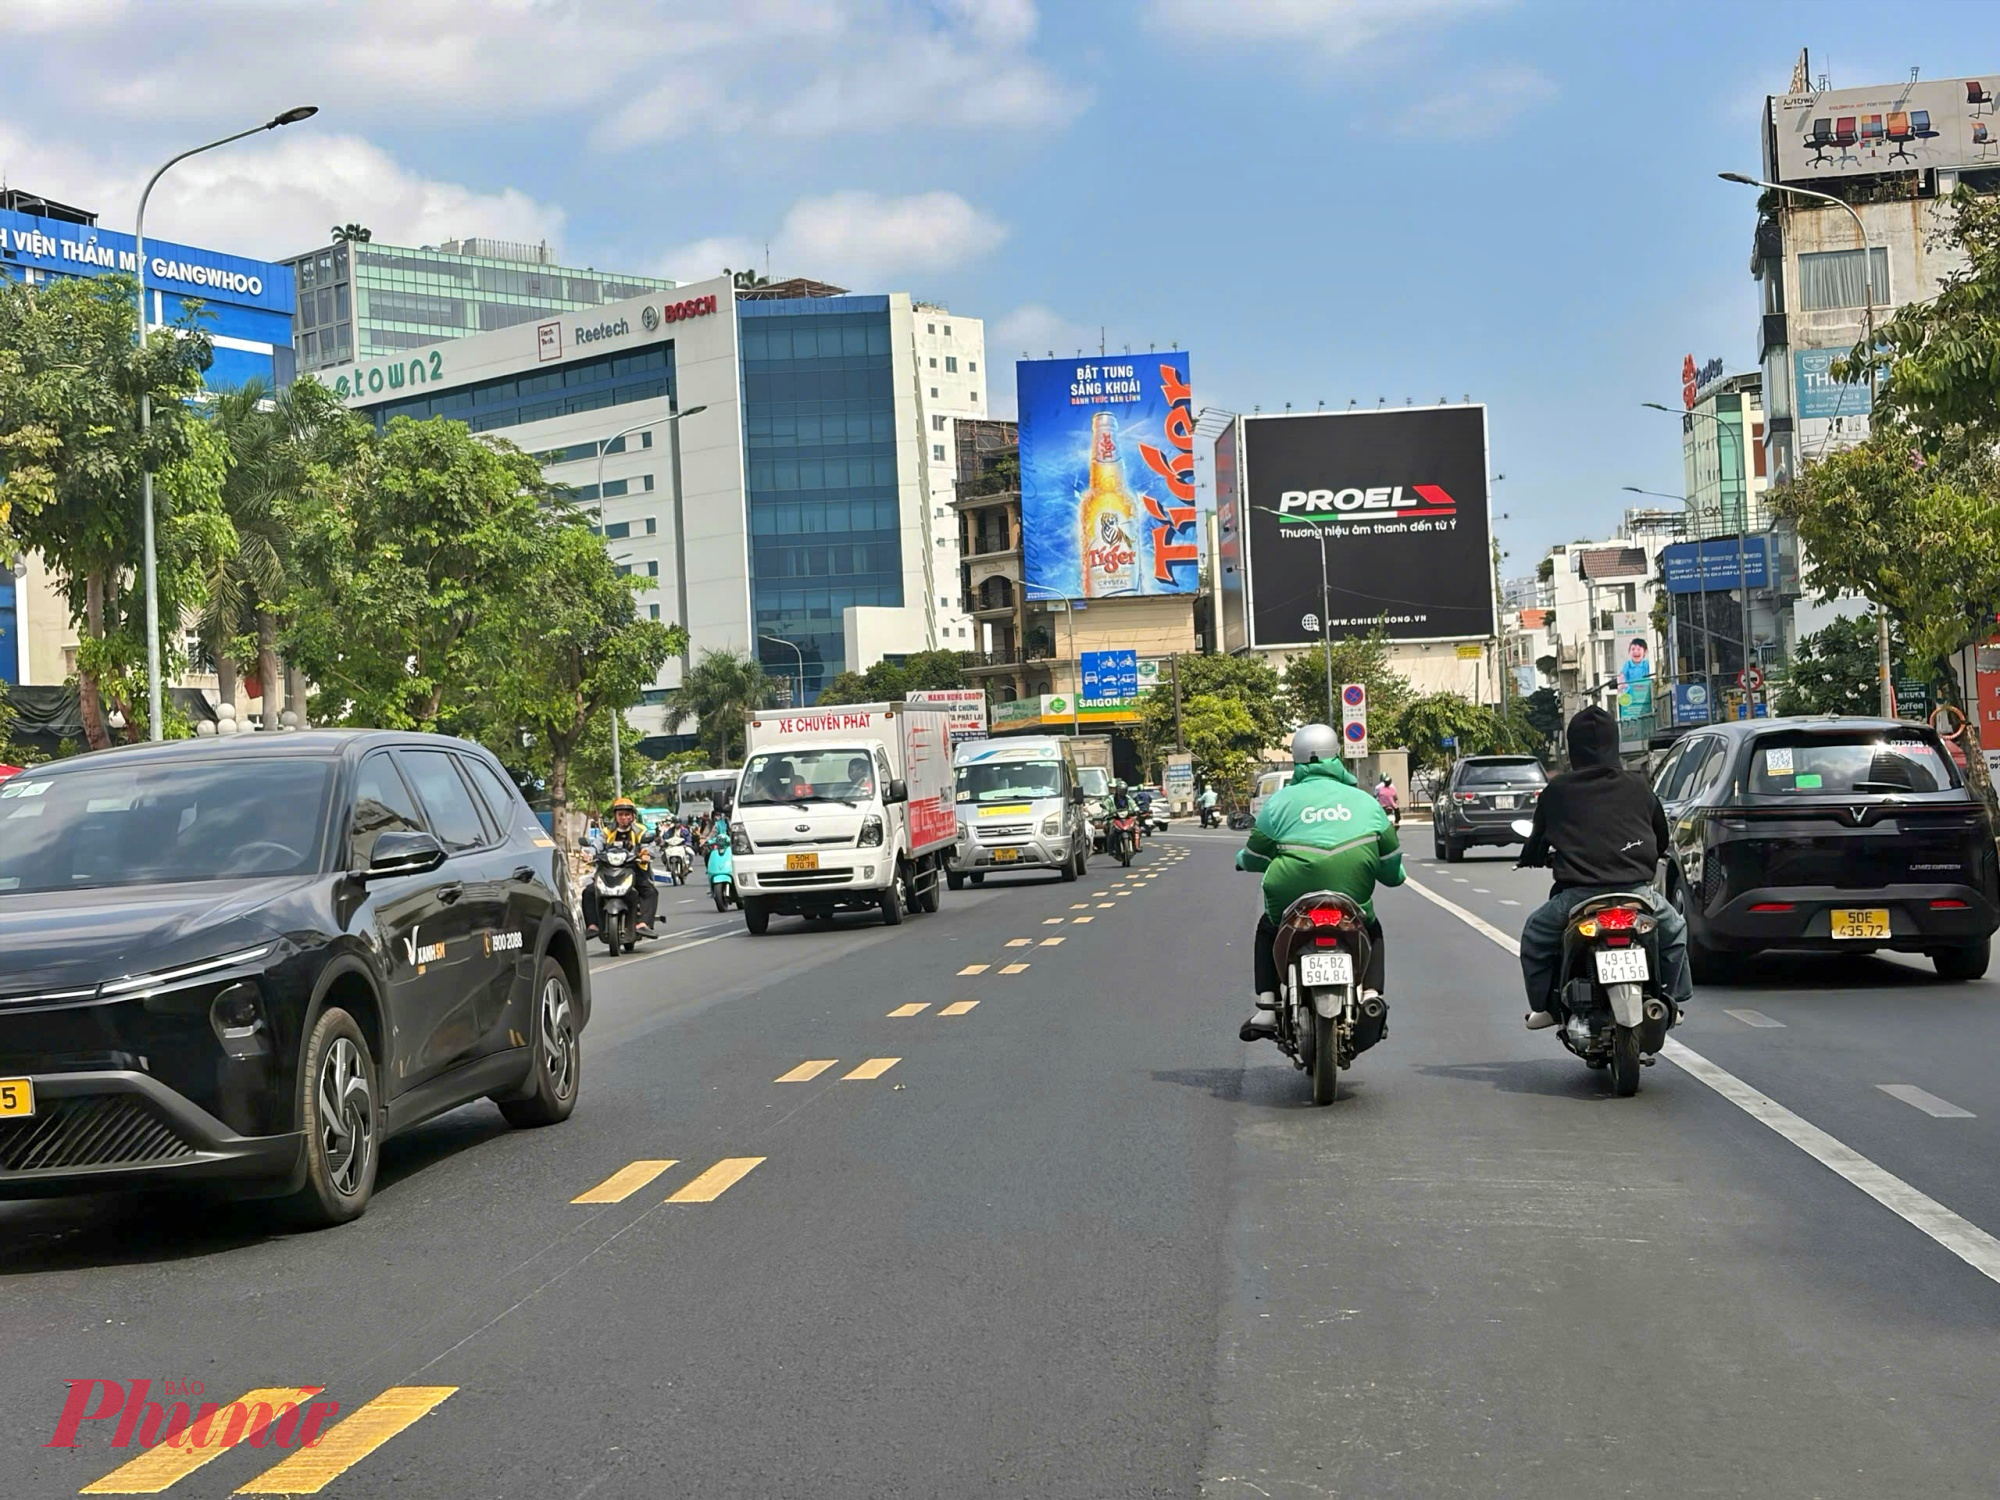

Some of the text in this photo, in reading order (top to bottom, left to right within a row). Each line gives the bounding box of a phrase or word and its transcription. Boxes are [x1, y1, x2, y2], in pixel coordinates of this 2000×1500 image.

[12, 229, 56, 259] VIỆN
[61, 236, 114, 269] THẨM
[152, 258, 262, 295] GANGWHOO
[664, 295, 717, 324] BOSCH
[575, 317, 629, 345] Reetech
[336, 350, 443, 400] e.town2
[1077, 364, 1134, 382] BẬT TUNG
[1070, 378, 1140, 396] SẢNG KHOÁI
[1138, 364, 1199, 584] Tiger
[1279, 486, 1417, 513] PROEL
[1279, 518, 1458, 540] Thương hiệu âm thanh đến từ Ý
[1089, 545, 1136, 573] Tiger
[1079, 697, 1120, 708] SAIGON
[779, 709, 870, 733] XE CHUYỂN PHÁT
[1300, 803, 1352, 824] Grab
[1848, 911, 1872, 924] 50E
[1839, 924, 1883, 938] 435.72
[492, 934, 506, 952] 1900
[417, 944, 436, 965] XANH
[1310, 957, 1344, 970] 64-B2
[1307, 970, 1348, 984] 594.84
[1601, 965, 1646, 981] 841.56
